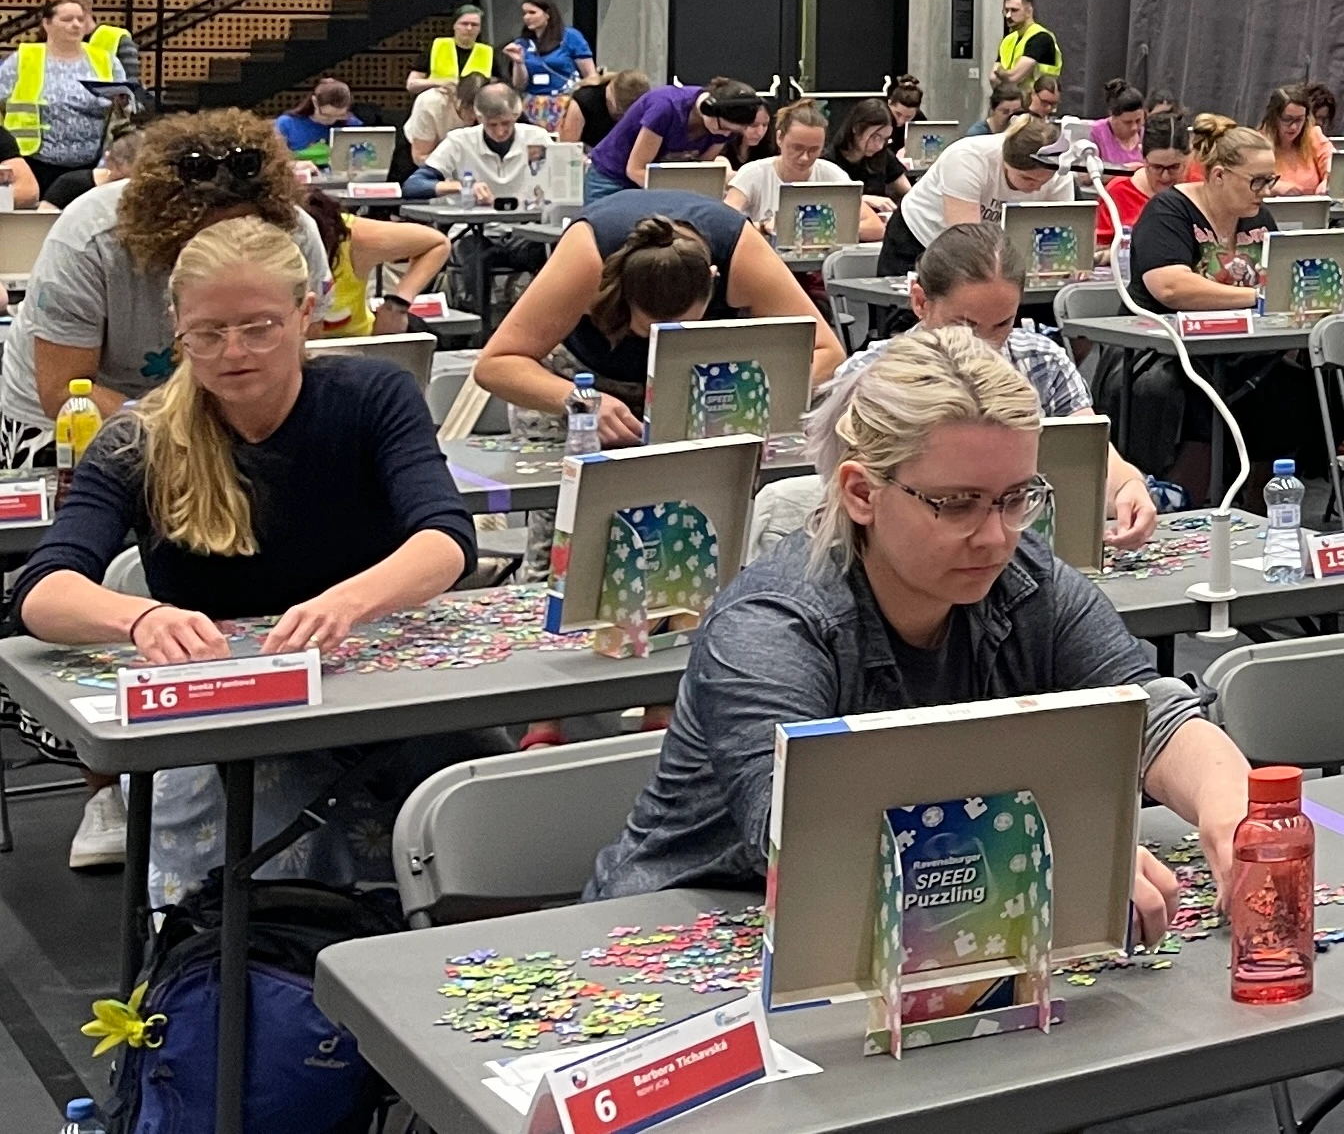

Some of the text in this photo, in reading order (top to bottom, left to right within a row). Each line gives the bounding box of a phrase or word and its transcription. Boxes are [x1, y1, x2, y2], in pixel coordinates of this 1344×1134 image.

[141, 686, 178, 710] 16
[912, 853, 982, 870] Ravensburger
[915, 867, 977, 890] SPEED
[904, 885, 986, 910] Puzzling
[632, 1061, 676, 1087] Barbora
[594, 1089, 617, 1123] 6
